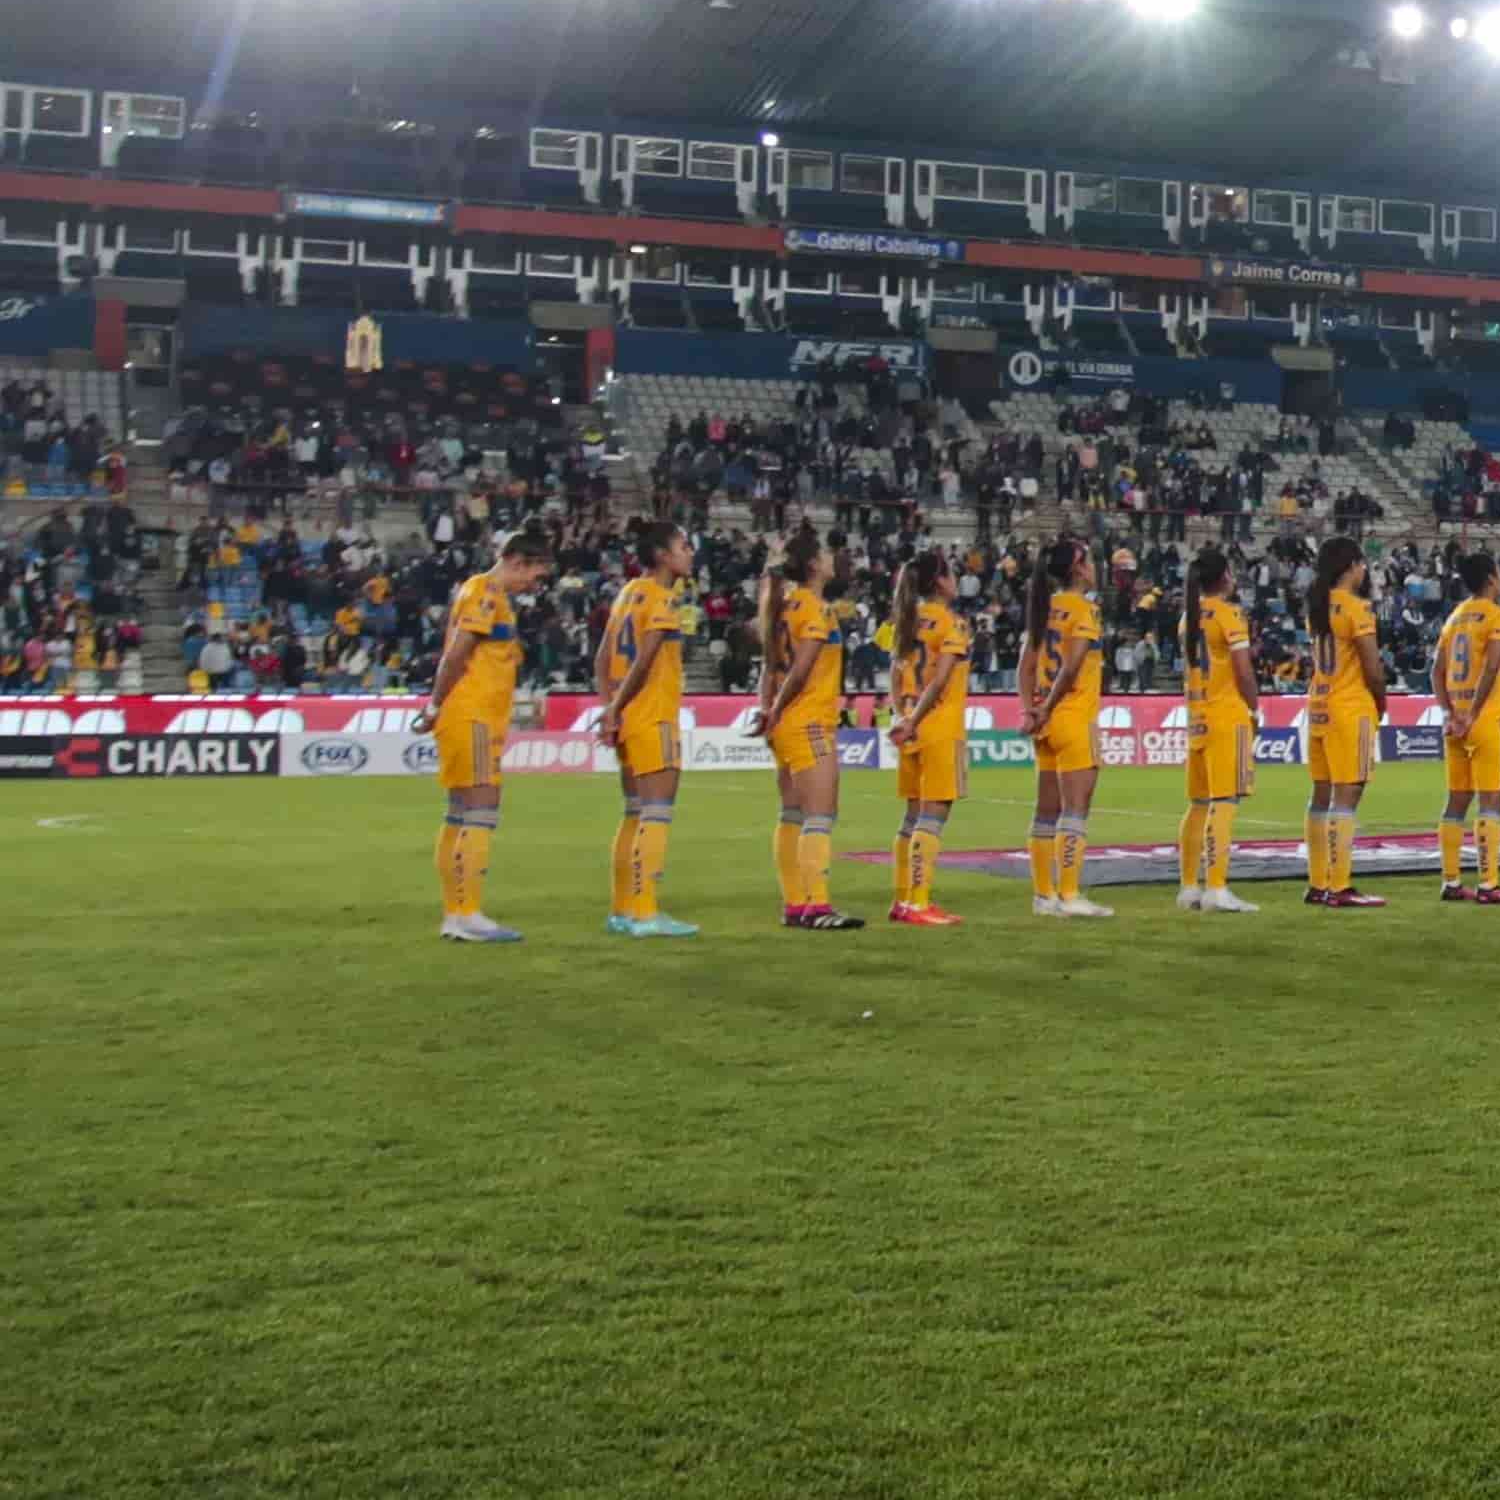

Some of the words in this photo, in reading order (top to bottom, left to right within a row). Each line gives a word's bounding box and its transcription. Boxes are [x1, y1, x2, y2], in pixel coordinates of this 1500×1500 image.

[816, 231, 872, 251] Gabriel
[1232, 261, 1282, 280] Jaime
[1288, 265, 1341, 285] Correa
[1451, 633, 1471, 683] 9
[106, 738, 276, 776] CHARLY
[313, 745, 353, 764] FOX
